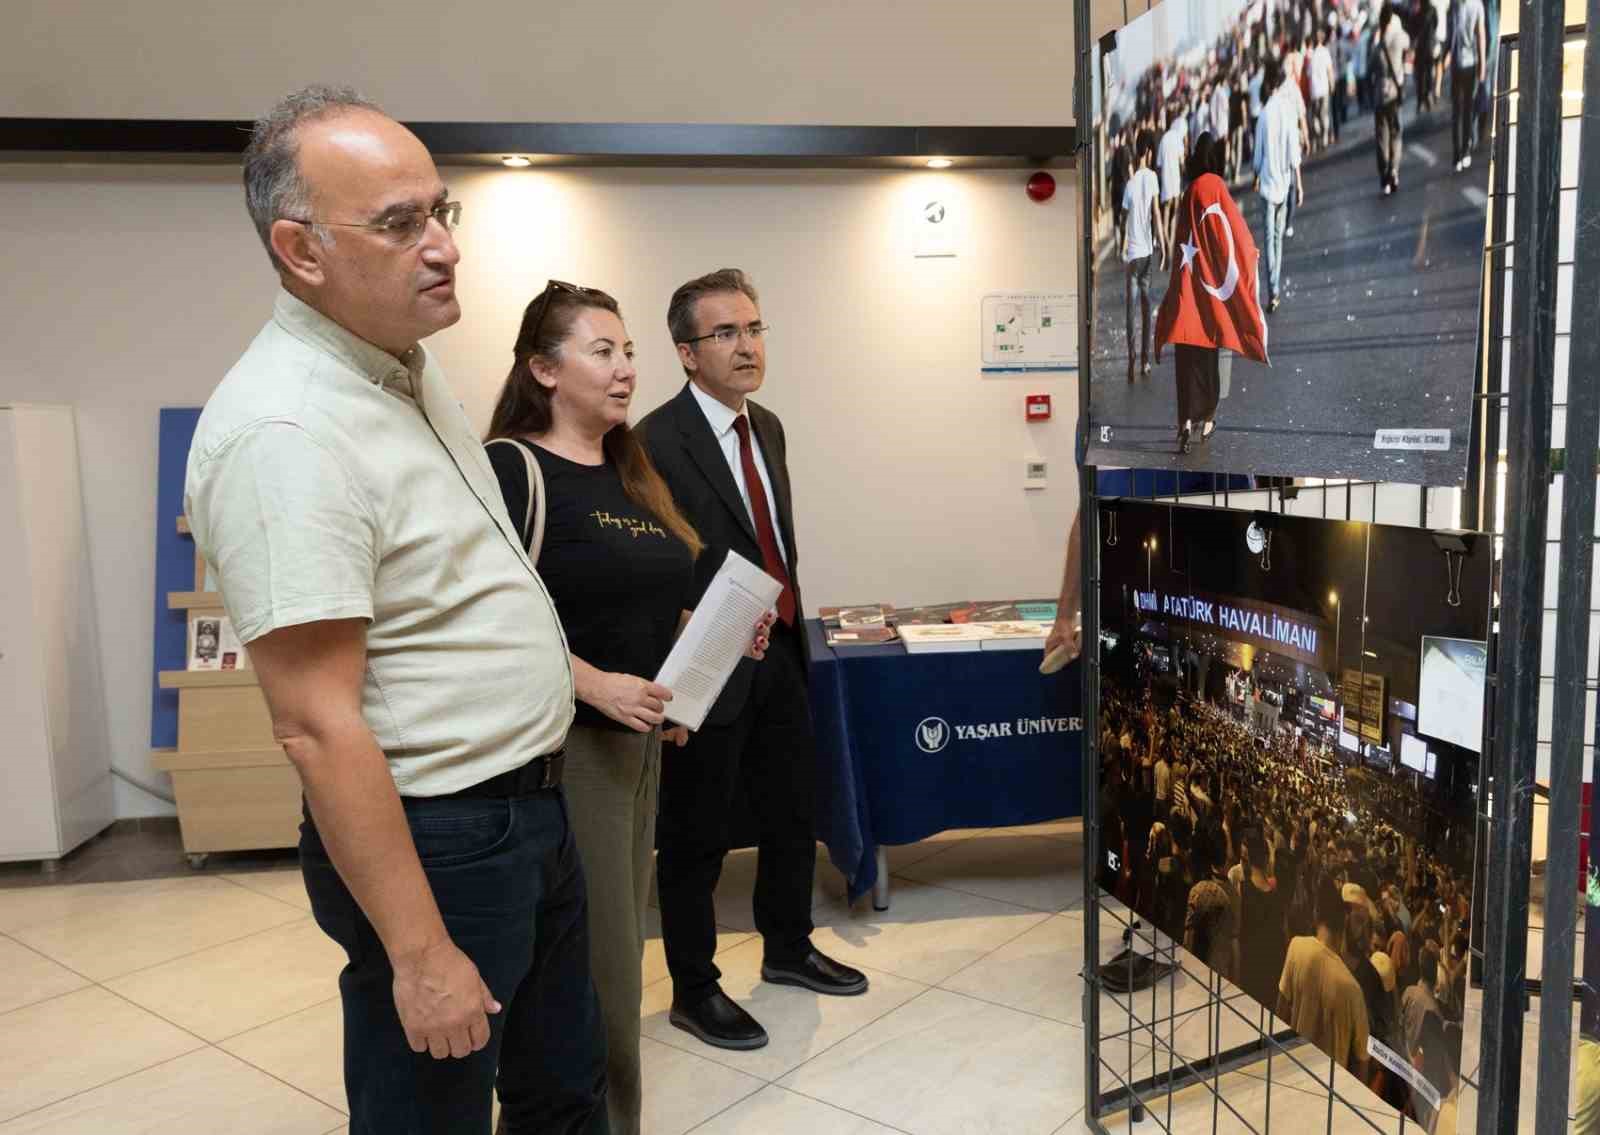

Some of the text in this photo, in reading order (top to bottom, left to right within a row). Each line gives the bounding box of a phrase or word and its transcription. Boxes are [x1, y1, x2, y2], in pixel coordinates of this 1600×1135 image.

[1163, 594, 1214, 624] ATATÜRK
[1219, 605, 1317, 653] HAVALİMANI
[955, 716, 1084, 741] YAŞAR ÜNİVER
